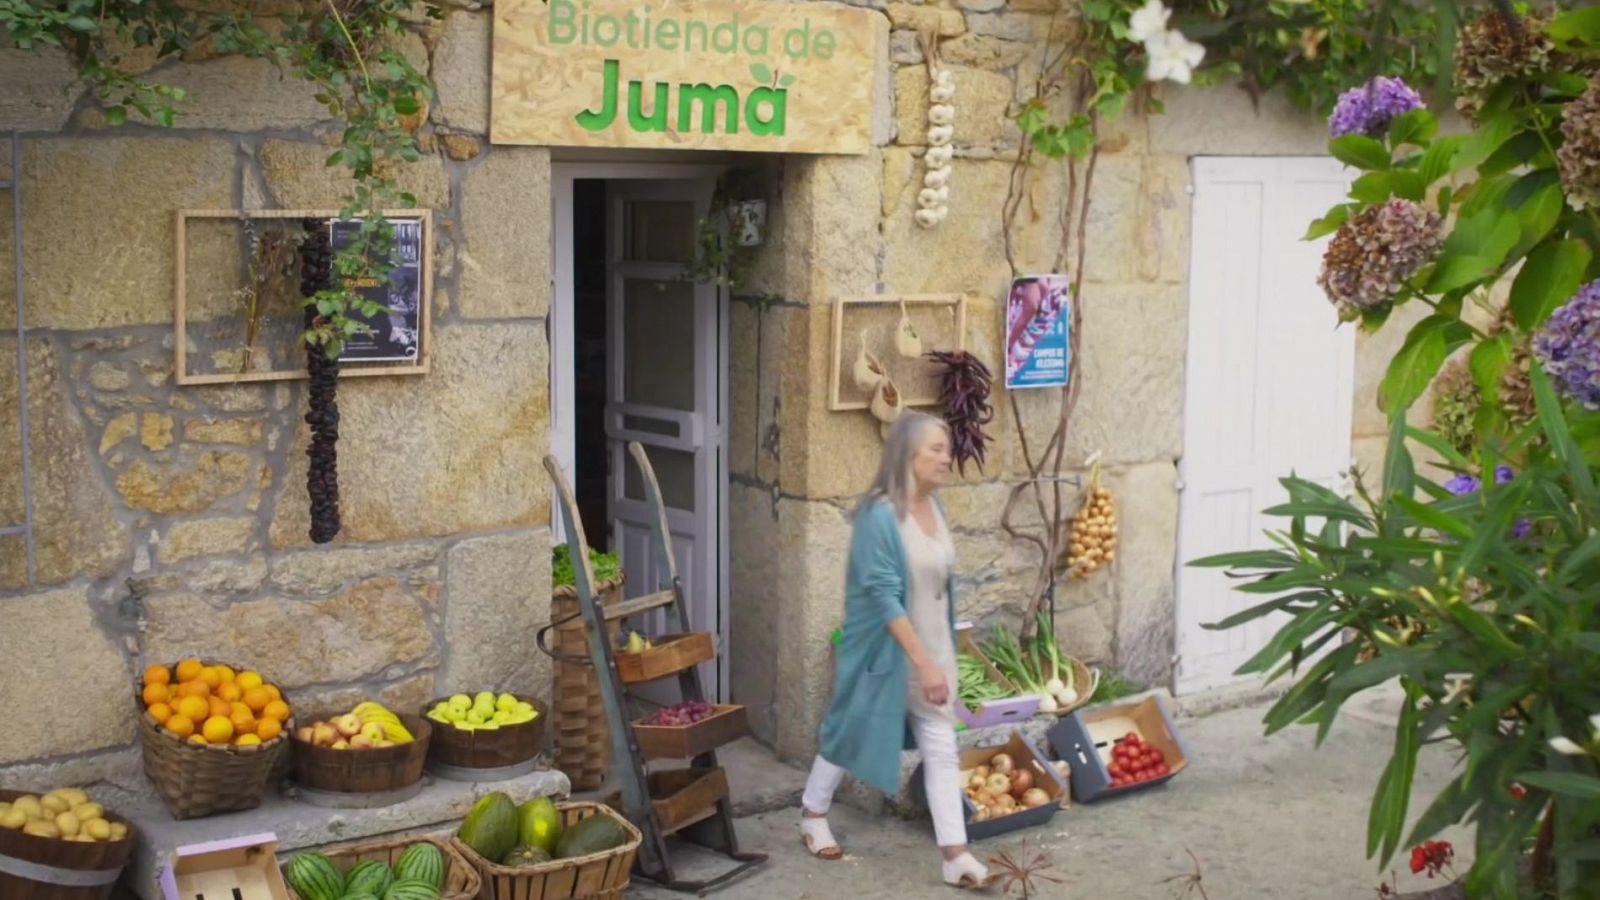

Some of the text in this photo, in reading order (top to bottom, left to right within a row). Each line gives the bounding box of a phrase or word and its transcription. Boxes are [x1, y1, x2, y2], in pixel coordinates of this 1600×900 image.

[547, 0, 837, 60] Biotienda de
[575, 59, 787, 136] Juma
